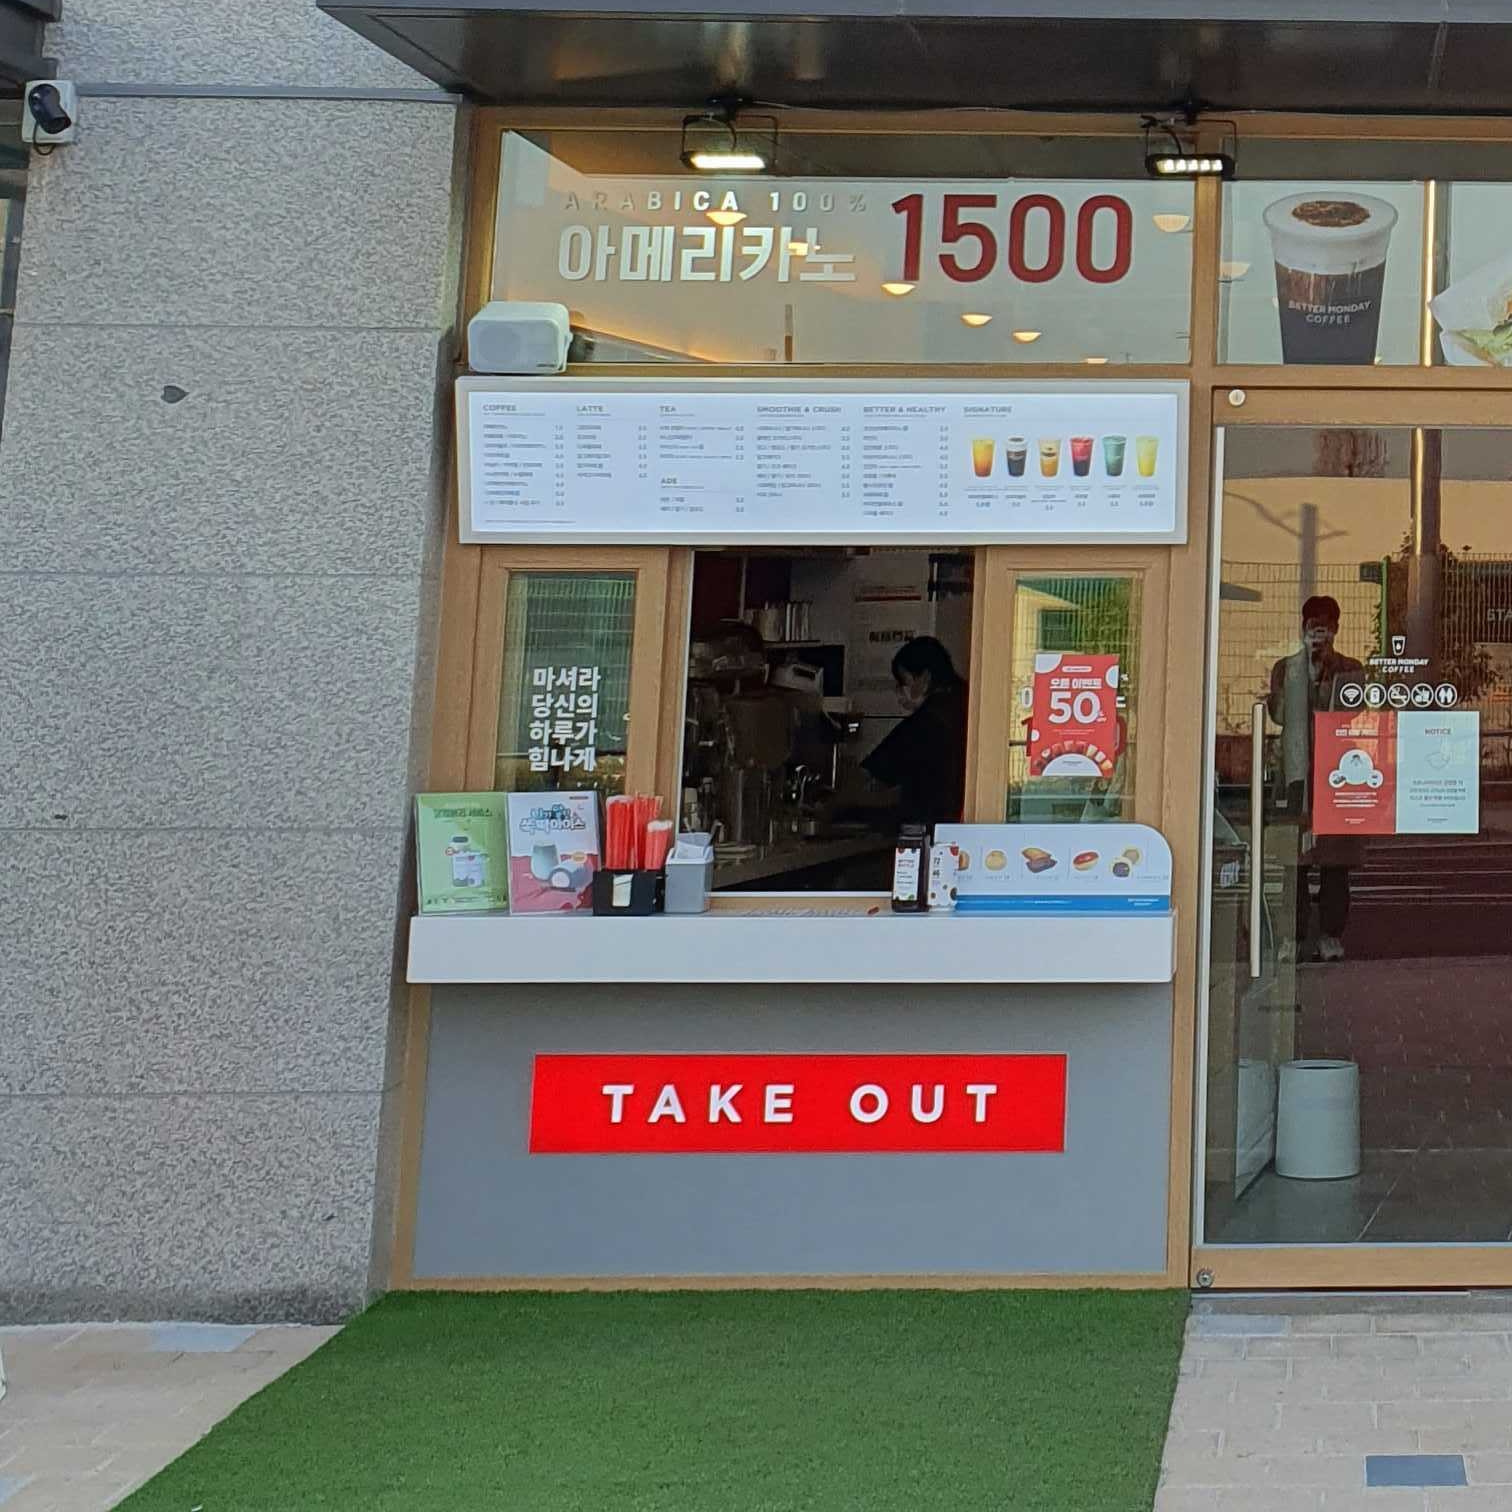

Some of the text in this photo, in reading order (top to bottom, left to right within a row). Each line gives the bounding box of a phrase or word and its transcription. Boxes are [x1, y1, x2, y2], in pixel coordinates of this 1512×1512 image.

[563, 190, 739, 212] ARABICA
[557, 193, 1133, 284] 아메리카노 1500
[576, 404, 604, 414] LATTE
[659, 405, 677, 414] TEA
[1369, 657, 1429, 666] BETTER MONDAY
[1382, 665, 1415, 674] COFFEE
[532, 666, 601, 691] 마셔라
[531, 693, 599, 719] 당신의
[528, 719, 598, 745] 하루가
[1424, 727, 1453, 737] NOTICE
[527, 746, 598, 773] 힘나게
[601, 1083, 998, 1124] TAKE OUT
